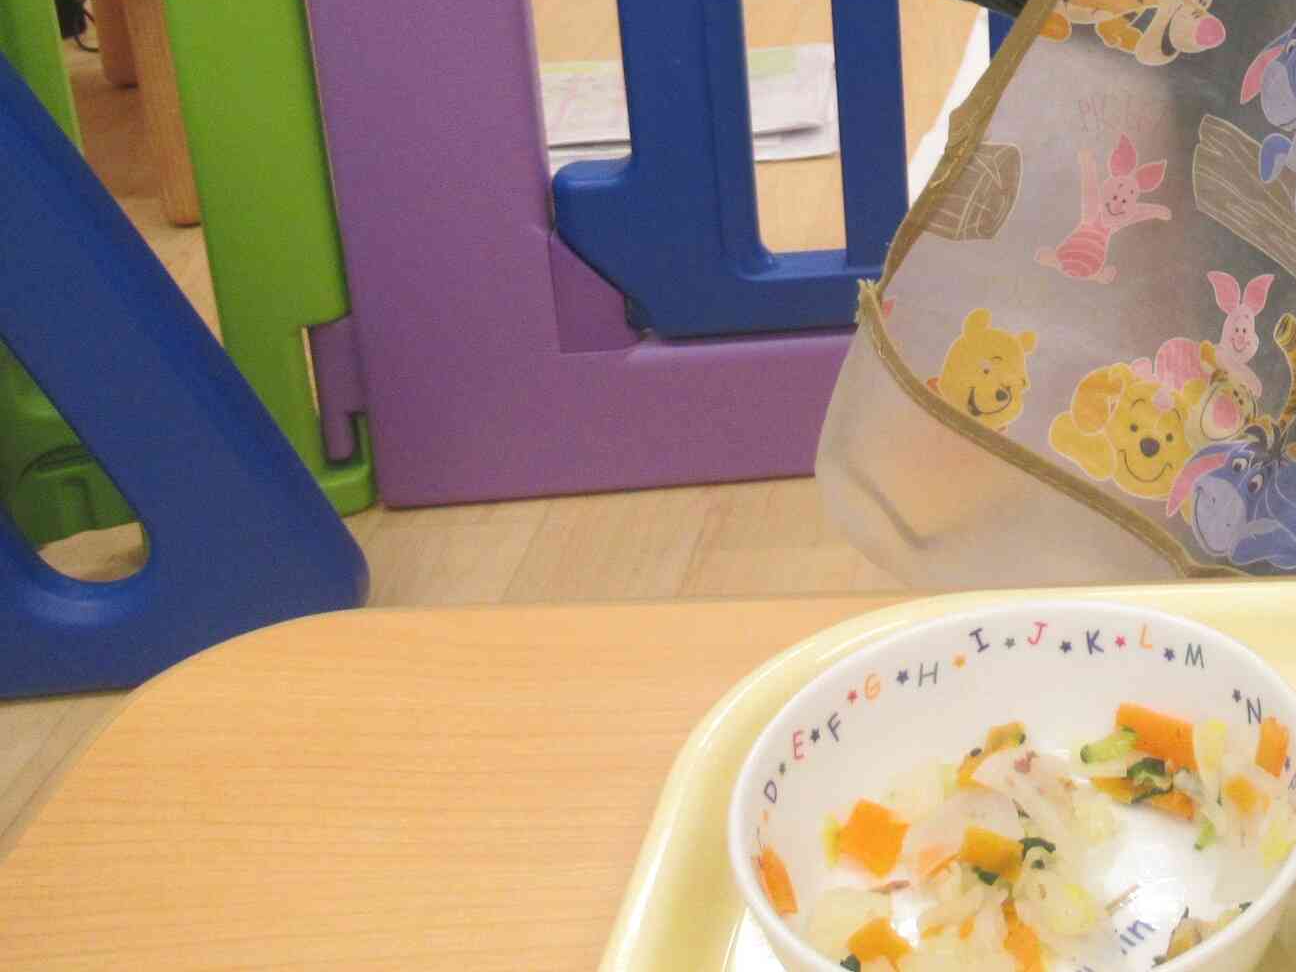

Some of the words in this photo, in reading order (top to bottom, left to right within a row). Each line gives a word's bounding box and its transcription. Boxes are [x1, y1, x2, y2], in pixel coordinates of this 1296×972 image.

[763, 780, 778, 804] D
[792, 730, 805, 761] E
[827, 712, 841, 742] F
[863, 672, 882, 701] G
[917, 662, 939, 687] H
[969, 627, 990, 653] I
[1027, 621, 1049, 646] J
[1086, 629, 1105, 656] K
[1138, 624, 1153, 650] L
[1184, 642, 1205, 669] M
[1246, 697, 1262, 725] N
